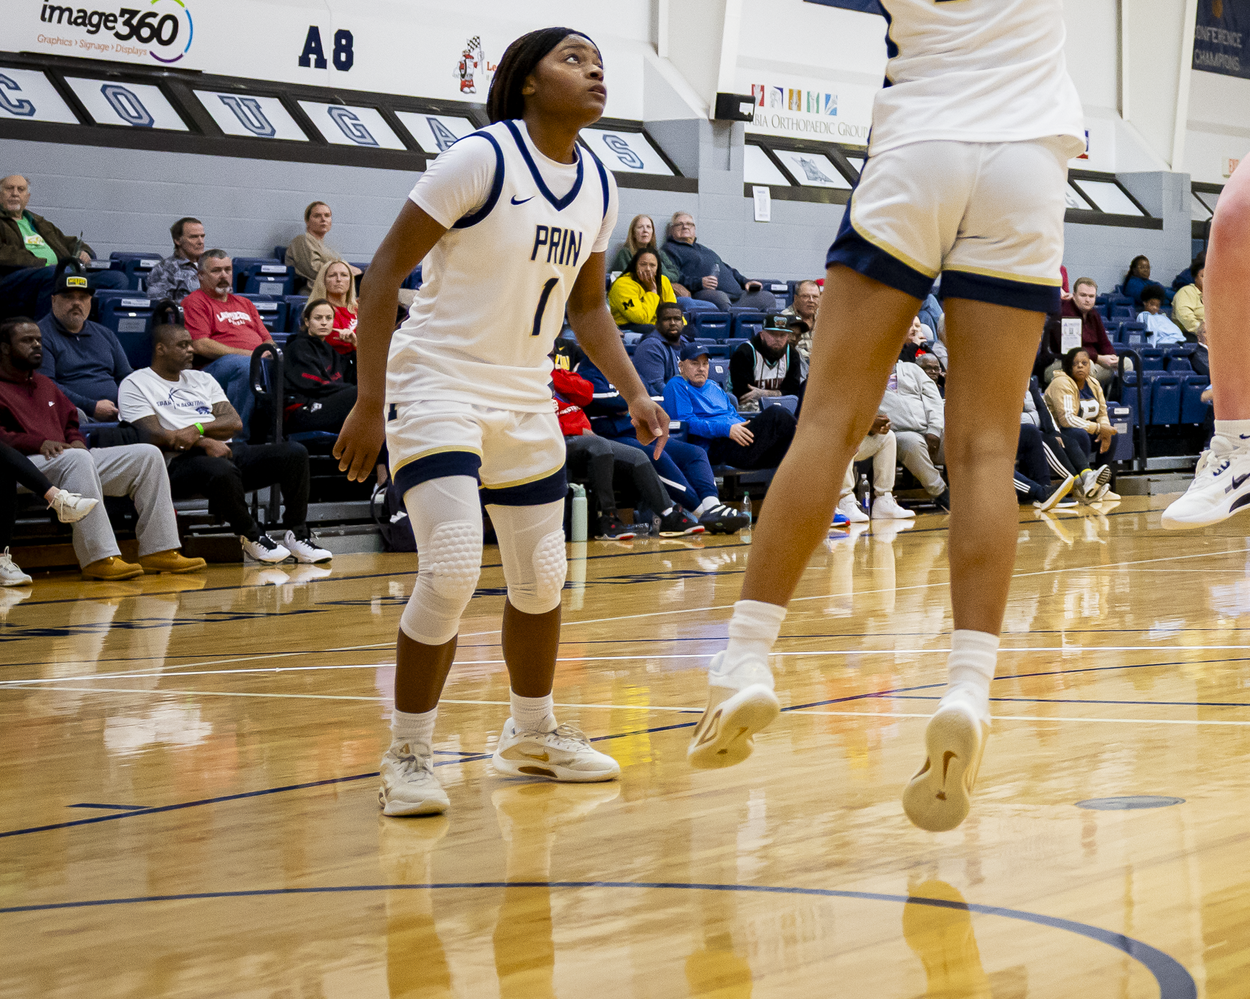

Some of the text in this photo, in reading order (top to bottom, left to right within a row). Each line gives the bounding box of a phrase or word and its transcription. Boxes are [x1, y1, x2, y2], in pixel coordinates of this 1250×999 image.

[37, 34, 147, 56] Graphics Signage Displays
[298, 25, 354, 72] A8
[1195, 25, 1242, 48] ONFERENCE
[771, 114, 835, 135] ORTHOPAEDIC
[530, 224, 582, 267] PRIN
[529, 277, 560, 337] 1
